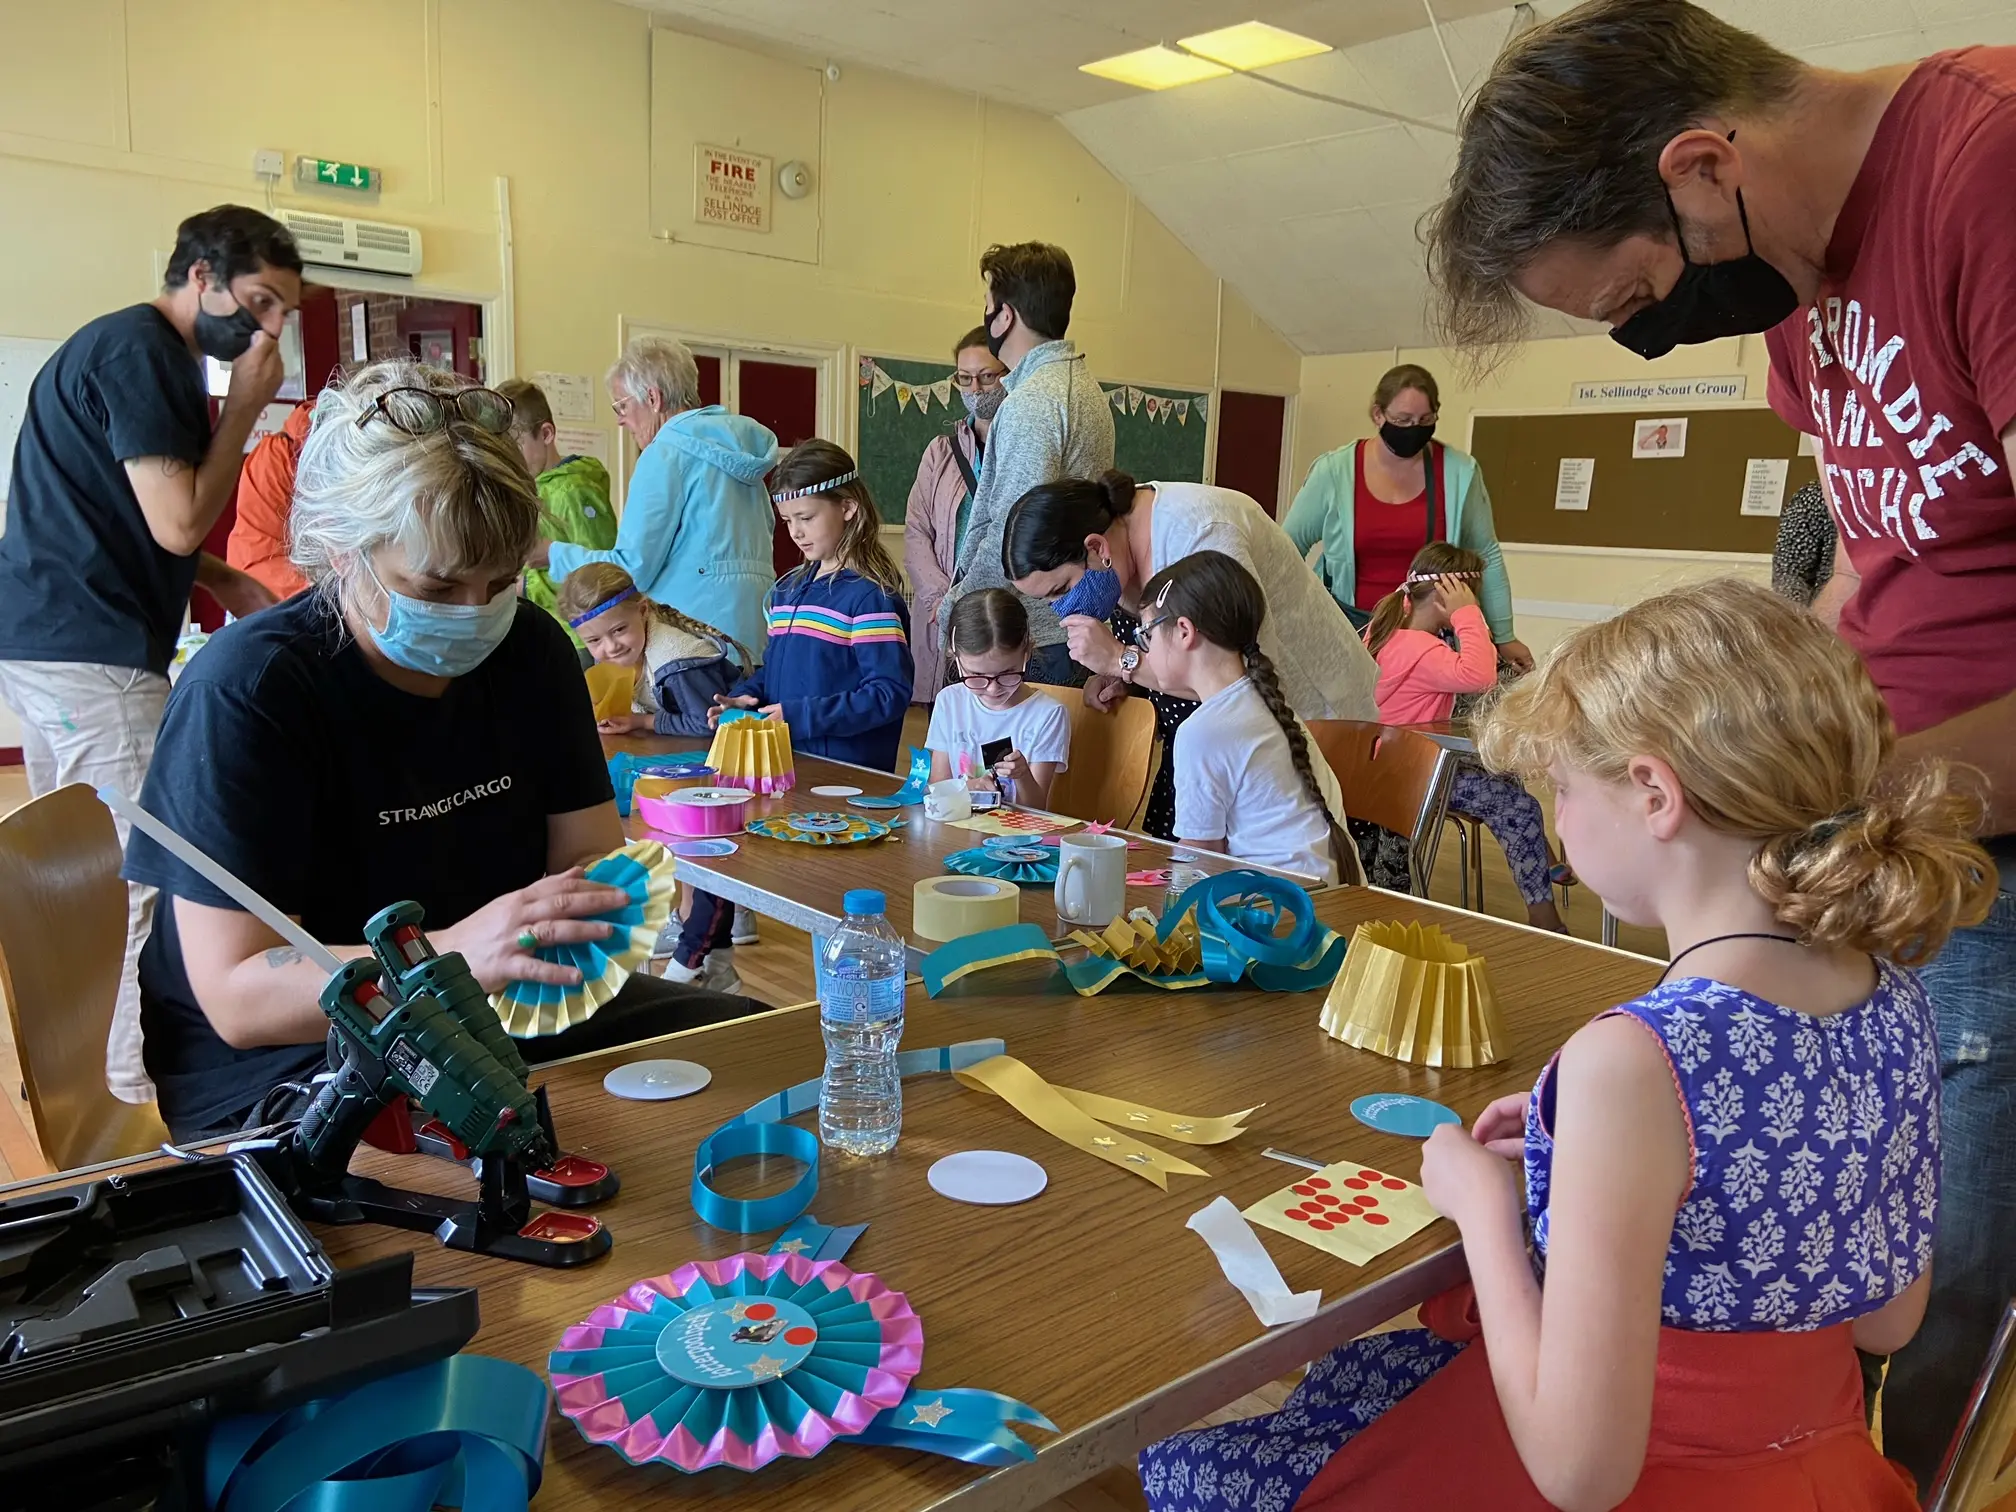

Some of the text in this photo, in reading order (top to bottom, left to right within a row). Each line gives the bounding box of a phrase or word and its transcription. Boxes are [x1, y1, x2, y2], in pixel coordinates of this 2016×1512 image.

[713, 151, 727, 161] THE
[728, 154, 750, 165] EVENT
[711, 160, 755, 182] FIRE
[705, 174, 756, 191] THE NEAREST
[709, 183, 754, 199] TELEPHONE
[704, 197, 762, 216] SELLINDGE
[703, 207, 761, 226] POST OFFICE
[1600, 385, 1654, 398] Sellindge
[1656, 384, 1691, 396] Scout
[1695, 382, 1737, 397] Group
